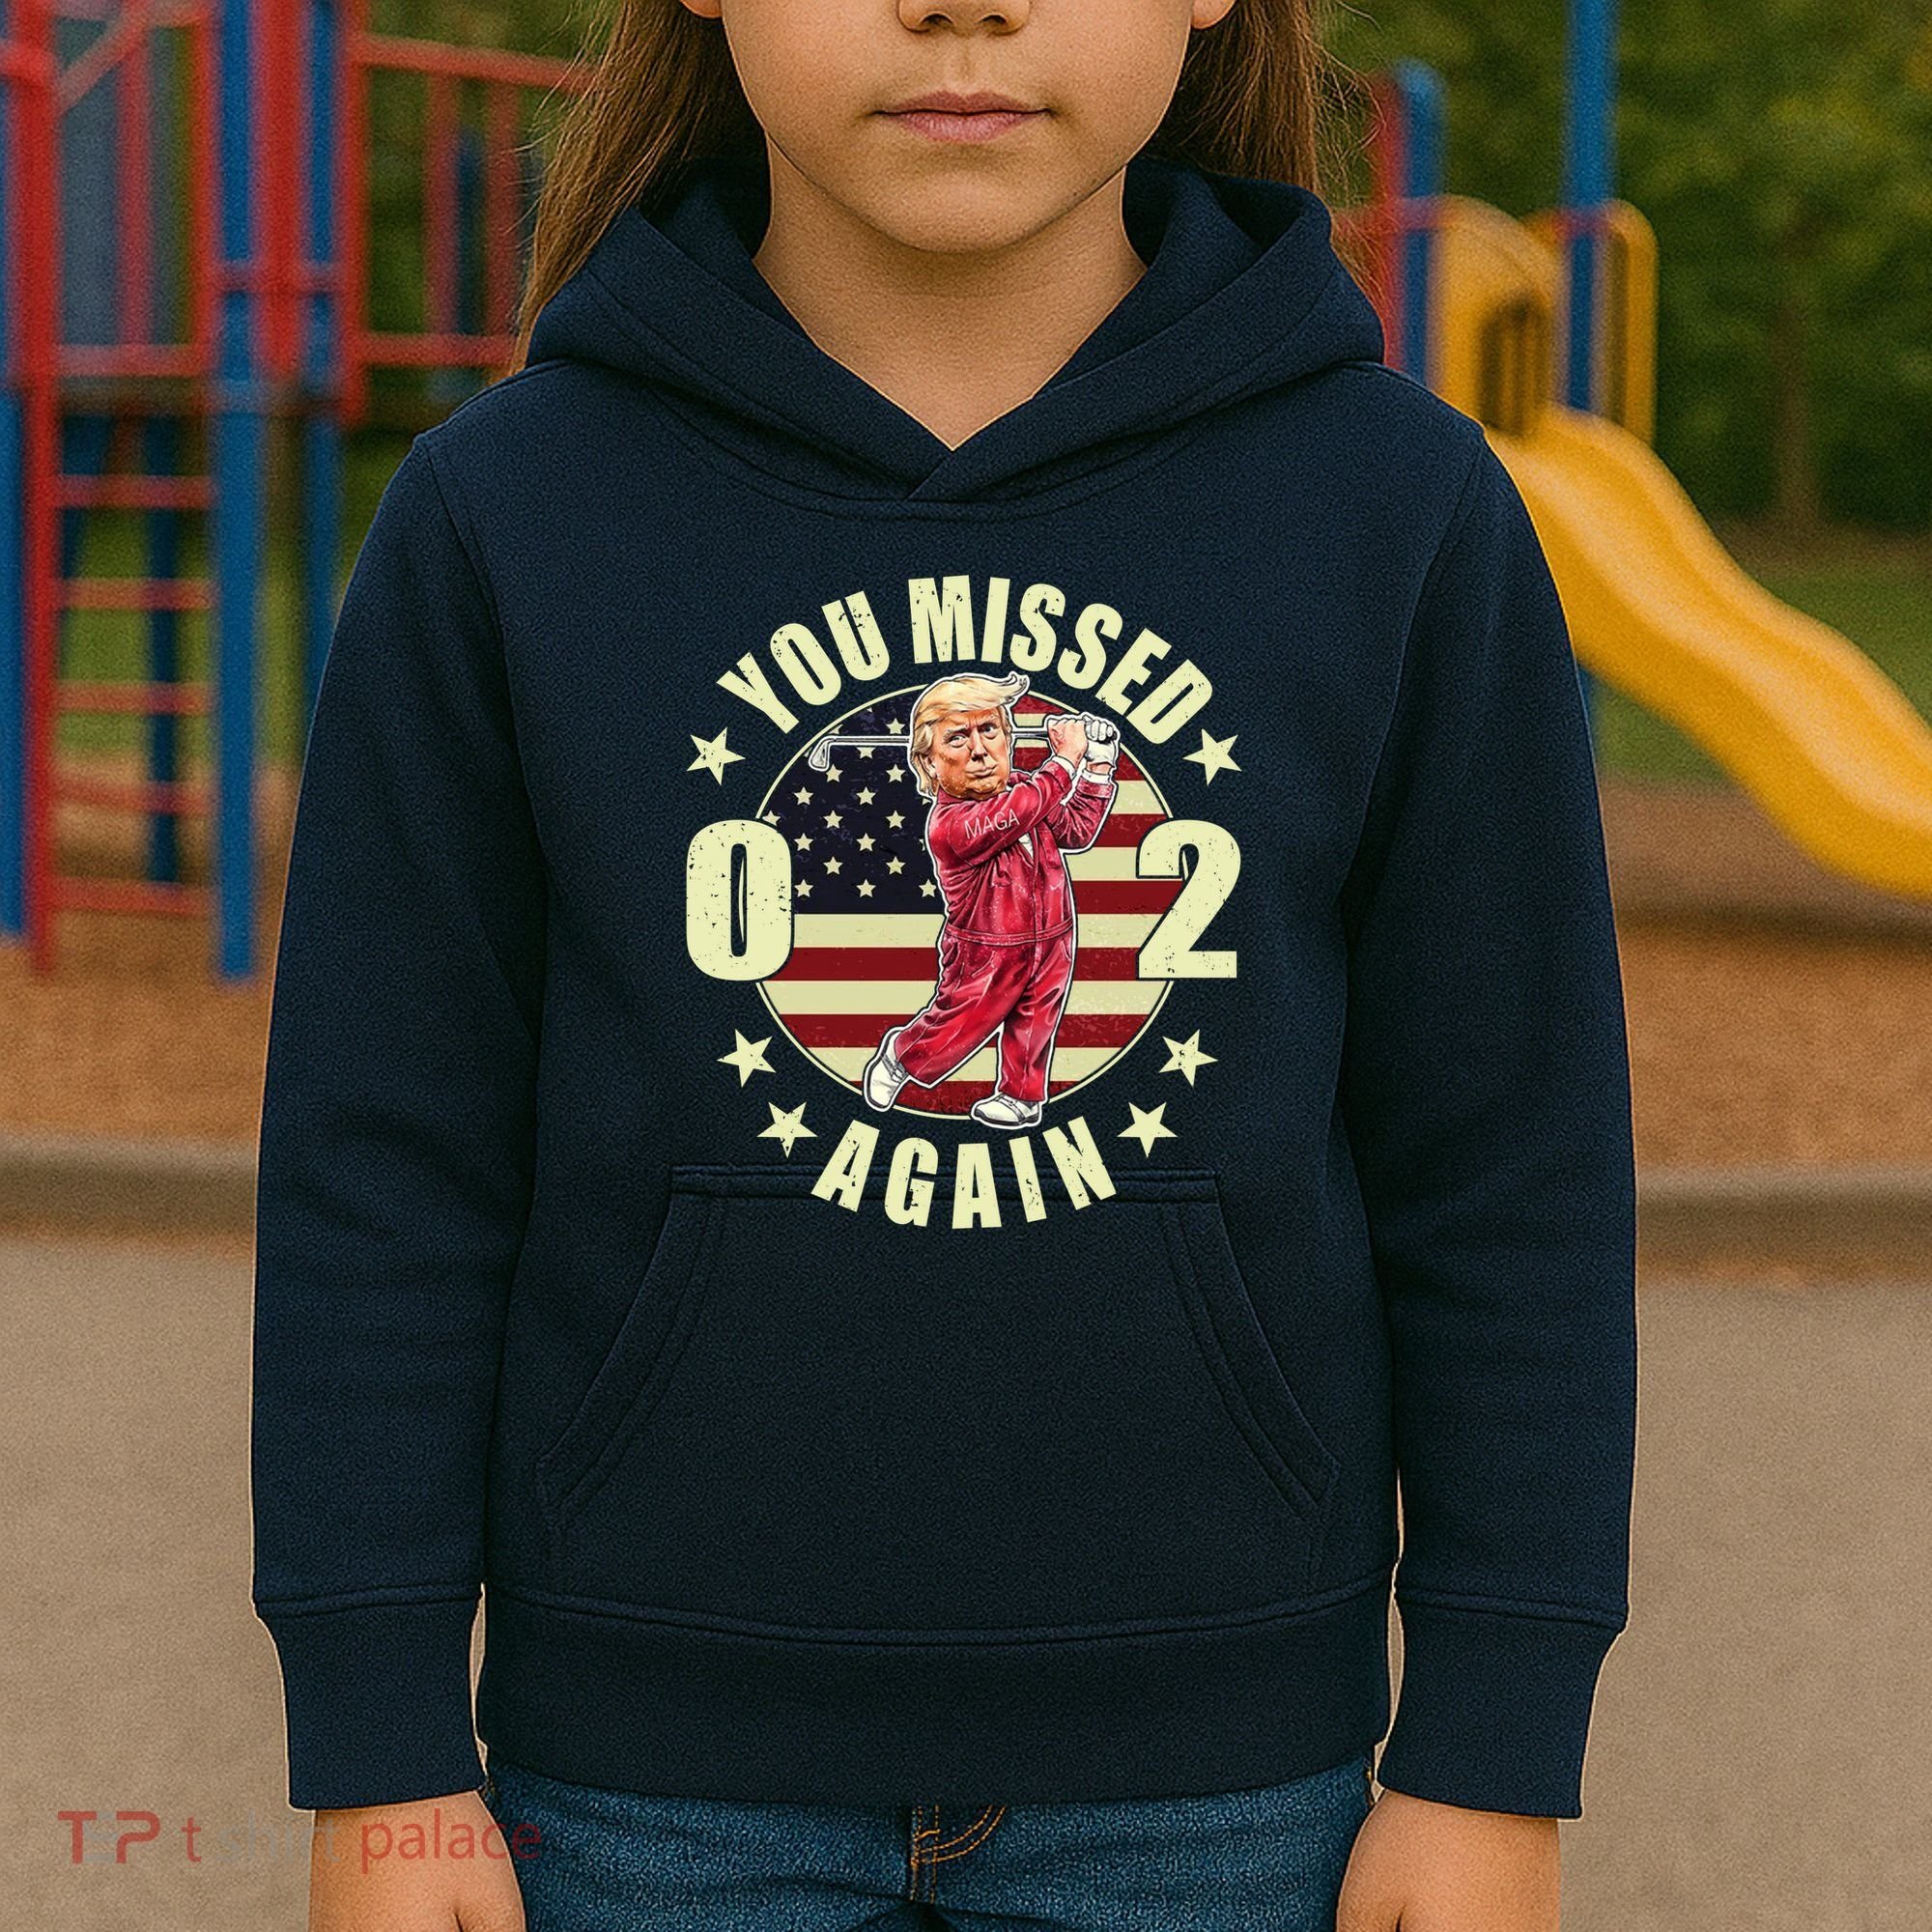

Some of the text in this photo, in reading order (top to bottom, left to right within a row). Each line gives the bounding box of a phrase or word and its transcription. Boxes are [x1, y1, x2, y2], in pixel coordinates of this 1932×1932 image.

[717, 576, 1212, 744] YOU MISSED
[964, 809, 1020, 838] MAGA
[1139, 820, 1240, 978] 2
[811, 1117, 1116, 1229] AGAIN
